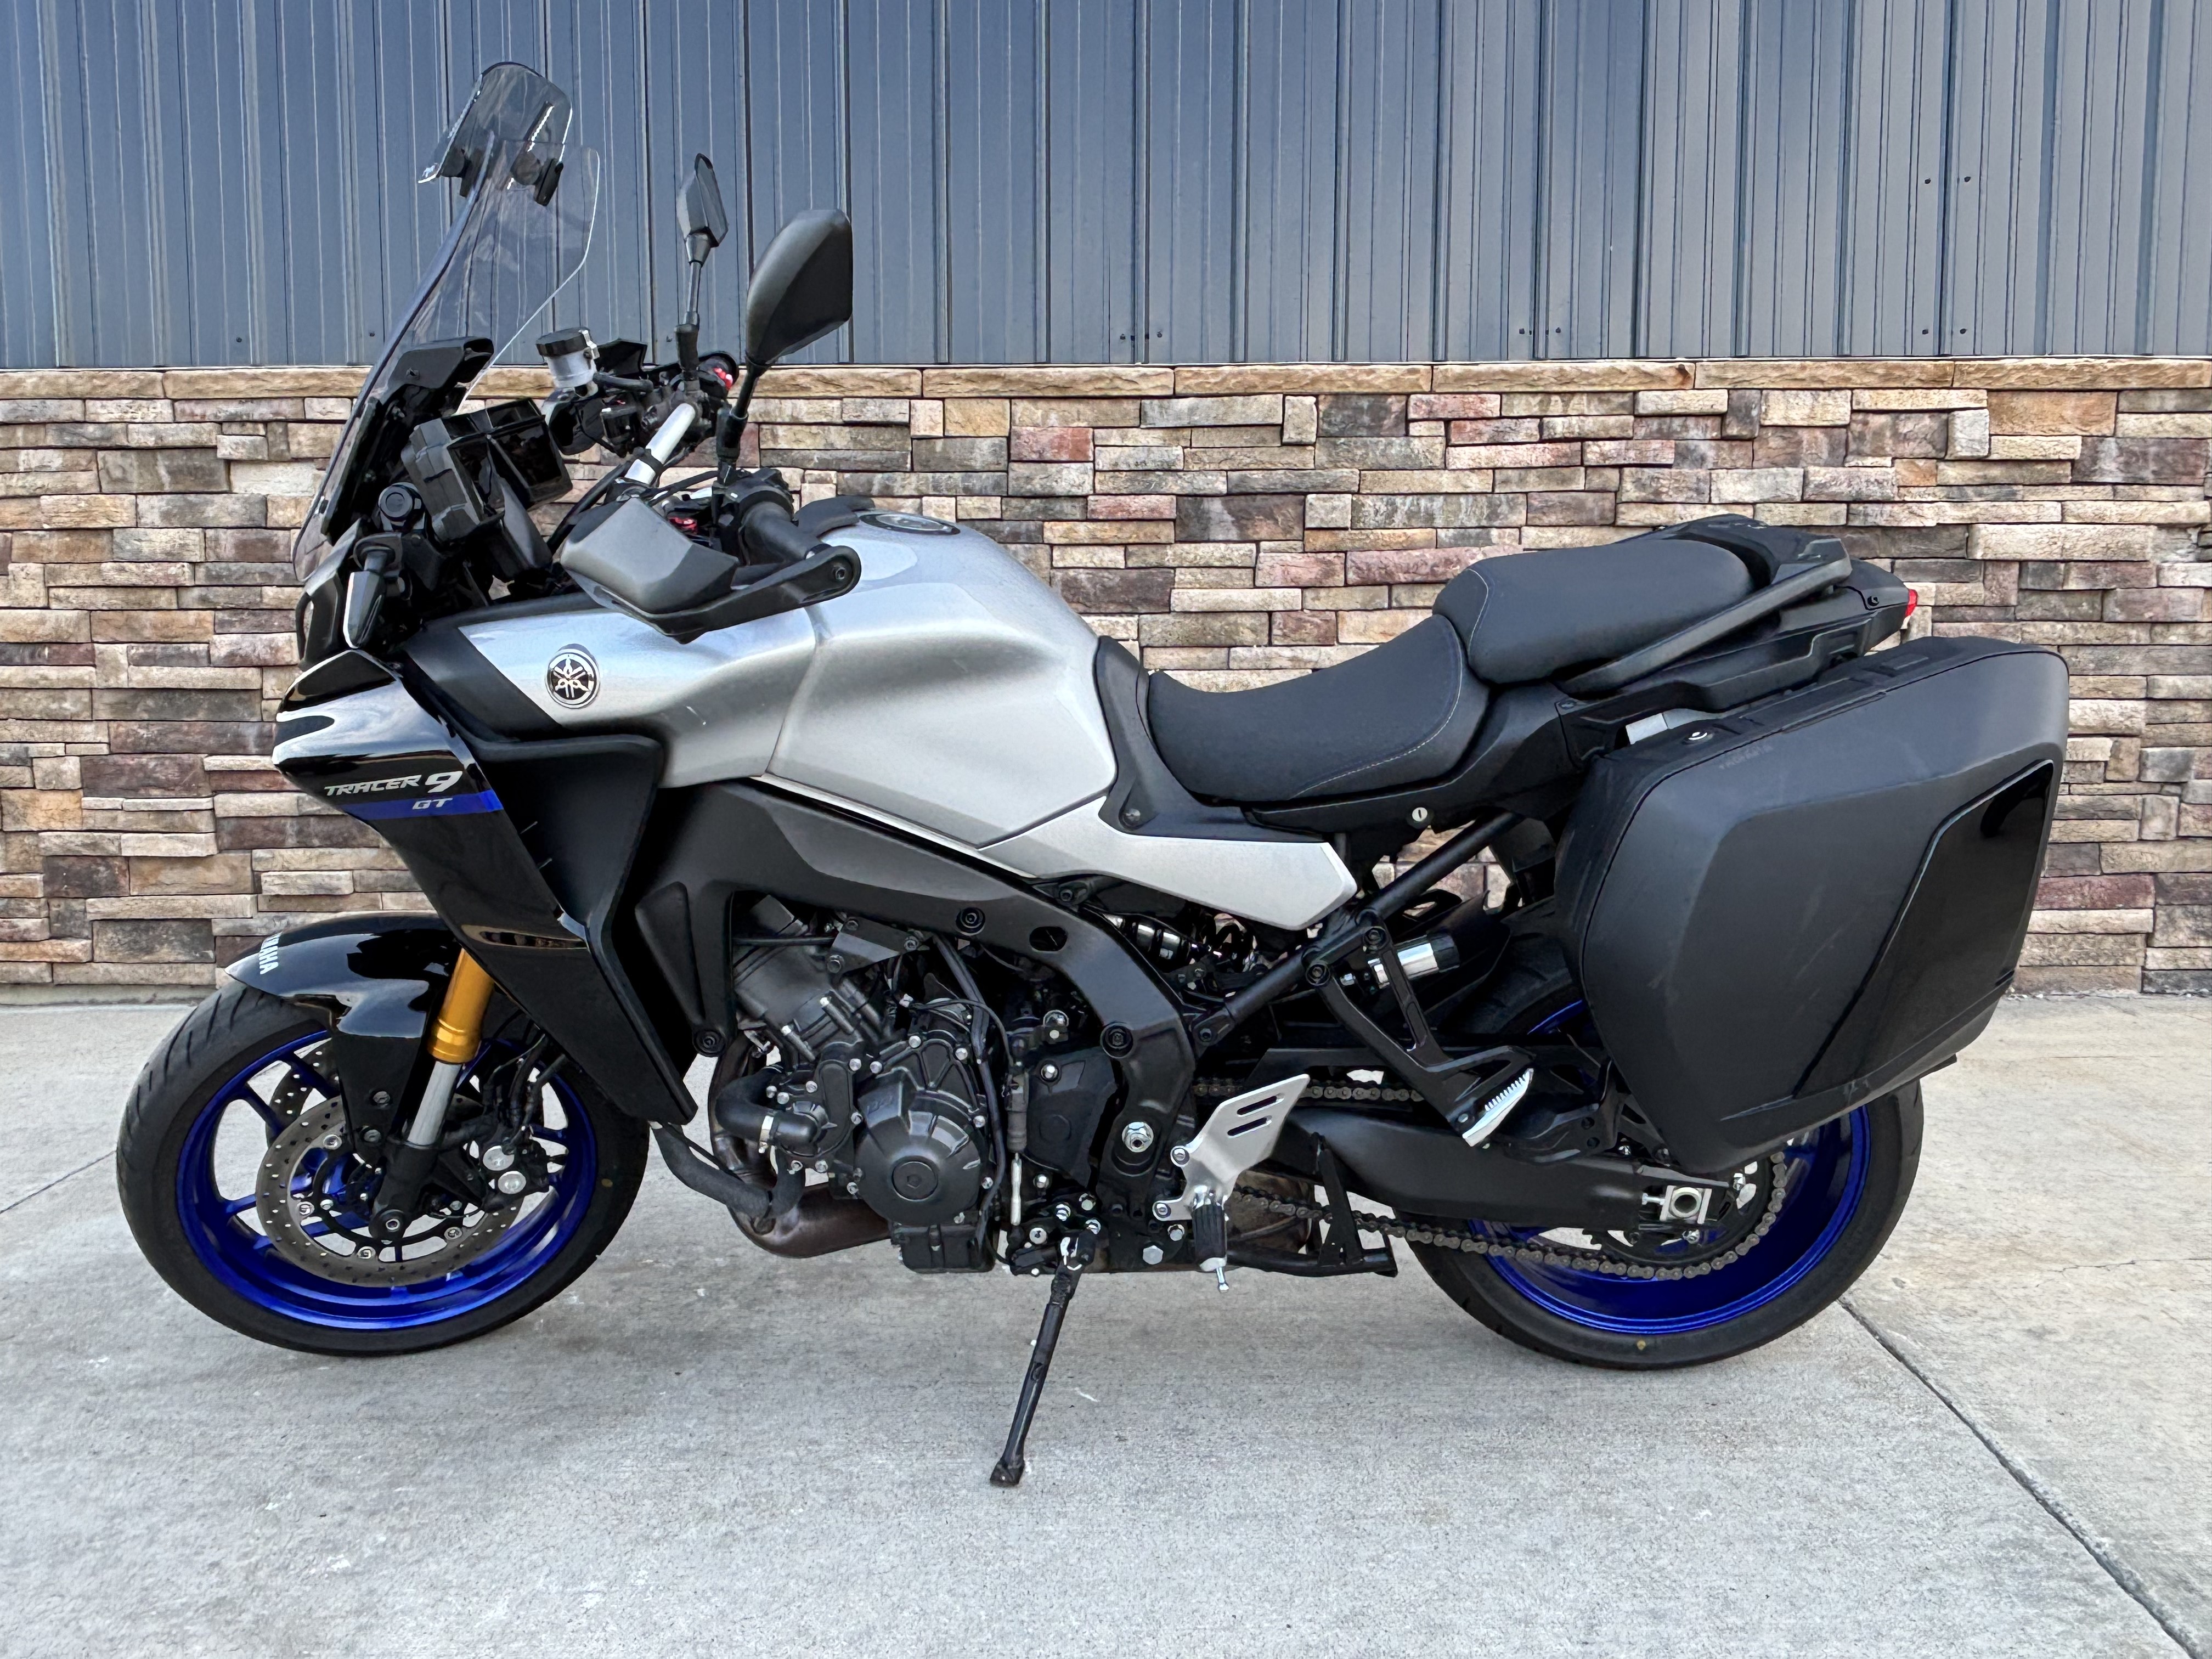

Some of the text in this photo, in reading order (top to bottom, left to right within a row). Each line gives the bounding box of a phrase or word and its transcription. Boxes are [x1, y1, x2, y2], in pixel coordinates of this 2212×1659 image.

[324, 771, 463, 795] TRACER 9
[413, 798, 453, 810] GT
[258, 932, 283, 975] MAHA
